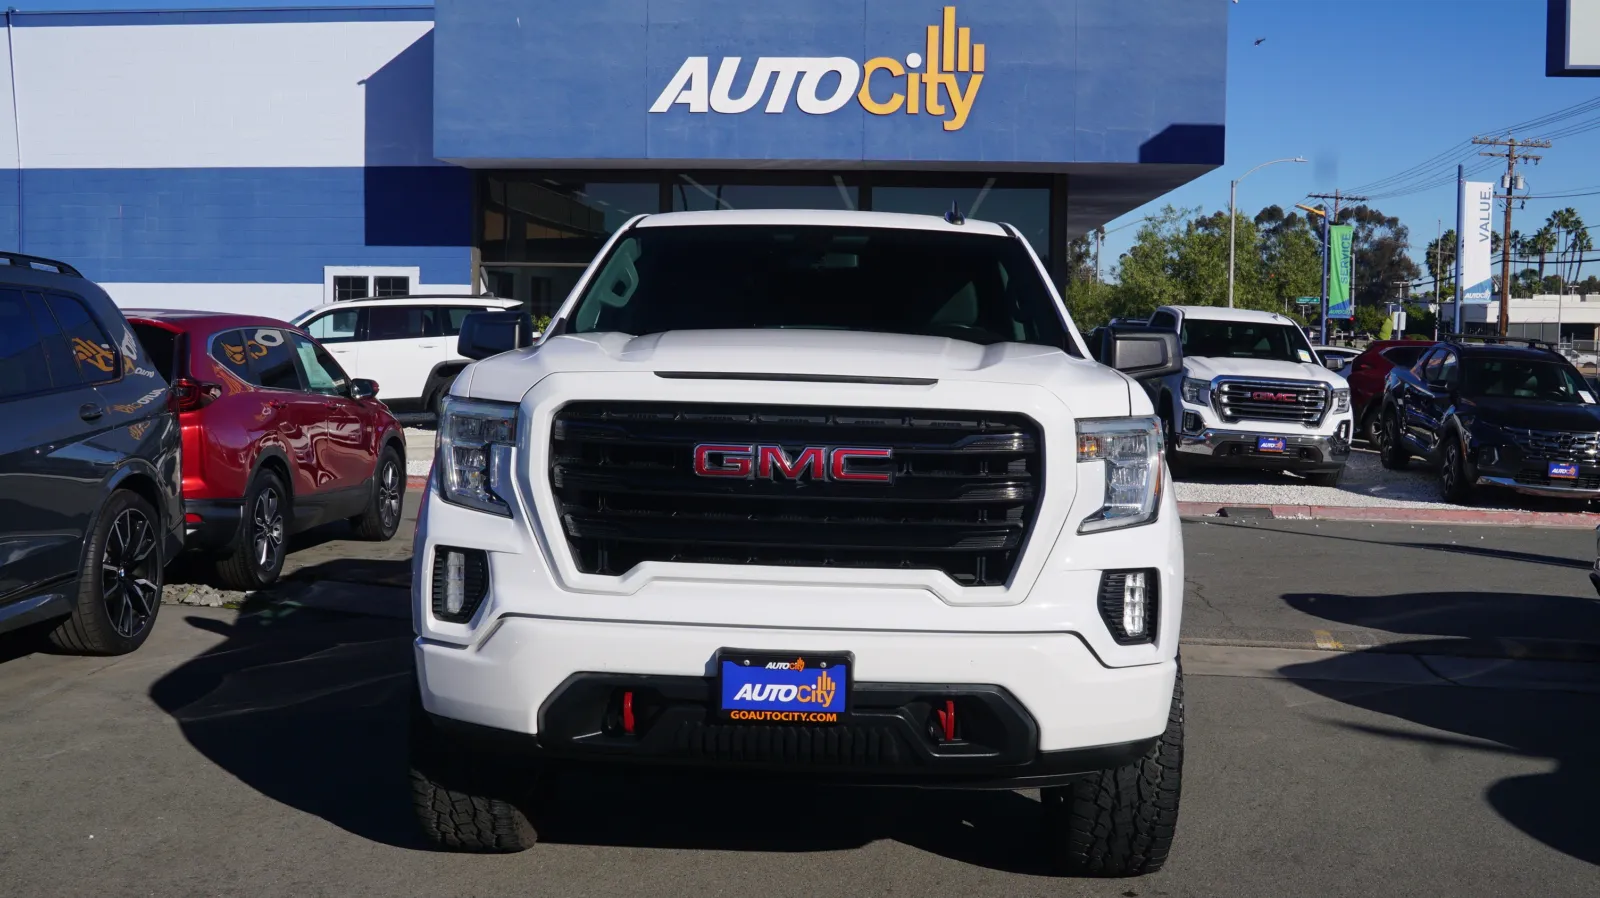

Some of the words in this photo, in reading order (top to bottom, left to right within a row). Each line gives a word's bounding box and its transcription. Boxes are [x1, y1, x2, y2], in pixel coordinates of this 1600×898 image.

[1252, 391, 1297, 402] GMC
[694, 443, 893, 483] GMC
[730, 710, 837, 722] GOAUTOCITY.COM
